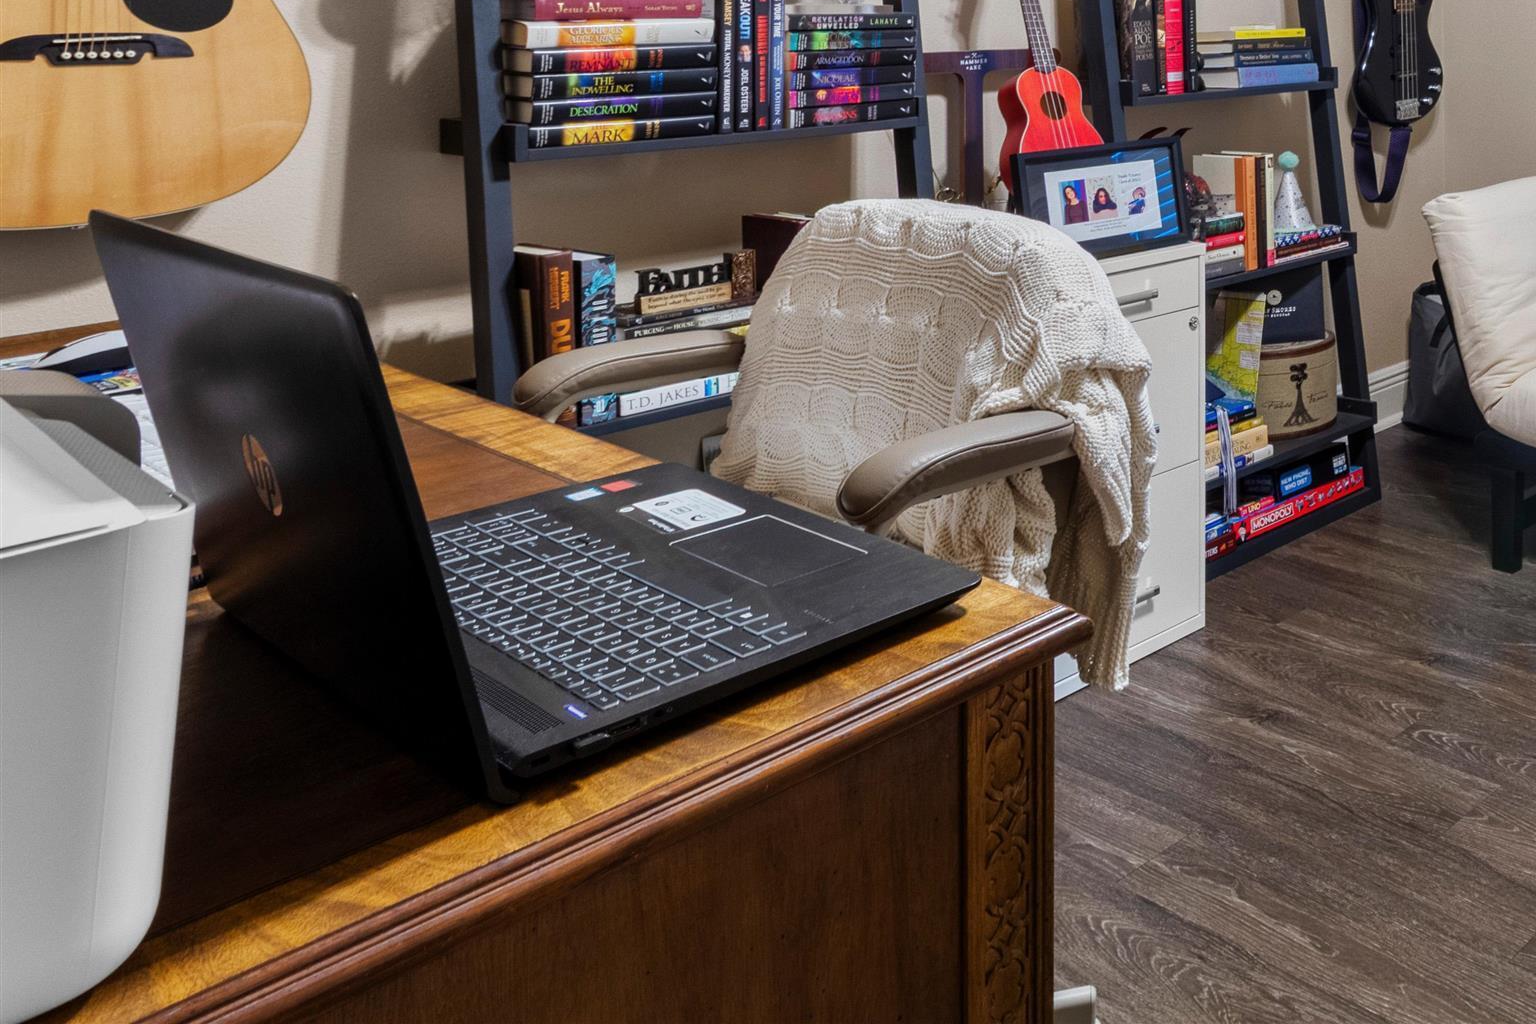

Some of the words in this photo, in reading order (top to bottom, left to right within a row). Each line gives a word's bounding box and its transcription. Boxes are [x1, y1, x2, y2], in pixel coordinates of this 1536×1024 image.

[773, 2, 782, 19] YOUR
[811, 15, 864, 24] REVELATION
[816, 22, 860, 30] UNVEILED
[869, 18, 900, 26] LAHAYE
[569, 25, 624, 36] GLORIOUS
[773, 19, 782, 38] TIME
[723, 32, 732, 51] TOTAL
[1134, 32, 1152, 46] POE
[569, 59, 634, 72] REMNANT
[723, 51, 732, 79] MONEY
[815, 53, 865, 65] ARMAGEDDON
[592, 75, 615, 86] THE
[740, 67, 749, 86] JOEL
[774, 76, 782, 90] JOEL
[571, 83, 634, 96] INDWELLING
[723, 78, 732, 113] MAKEOVER
[740, 85, 749, 114] OSTEEN
[774, 89, 783, 116] OSTEEN
[570, 103, 639, 117] DESECRATION
[571, 128, 626, 145] MARK
[634, 252, 734, 294] FAITH
[560, 270, 571, 303] FRANK
[633, 325, 665, 338] PURGING
[673, 321, 696, 331] HOUSE
[626, 396, 655, 411] T.D.
[658, 385, 700, 406] JAKES
[241, 433, 284, 517] hp
[1281, 475, 1294, 485] NEW
[1284, 482, 1297, 491] WHO
[1247, 503, 1261, 514] UNO
[1252, 505, 1293, 531] MONOPOLY
